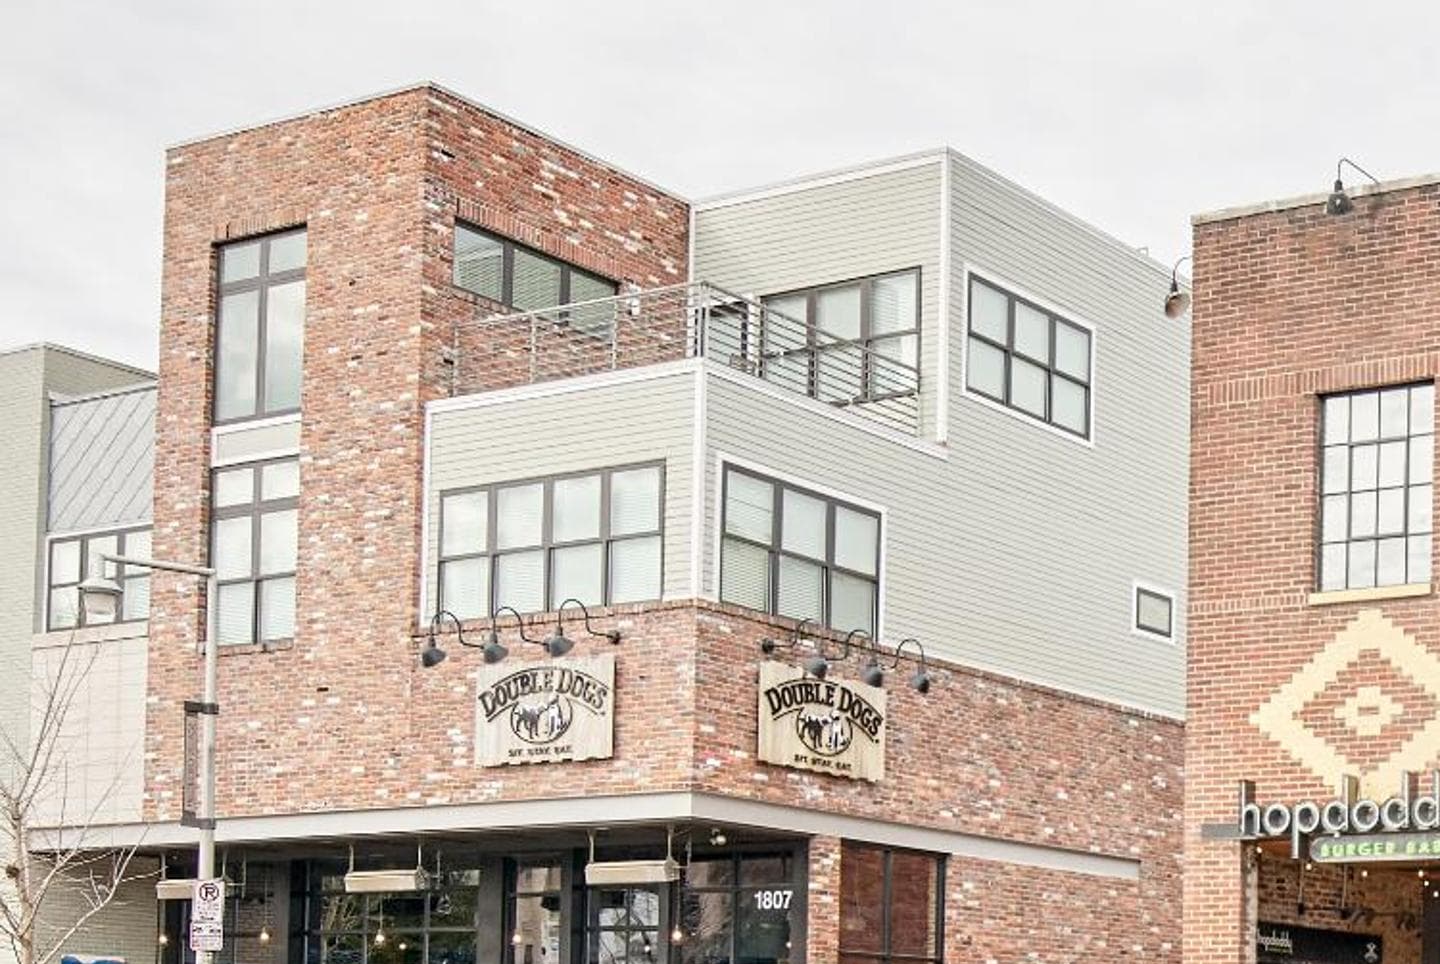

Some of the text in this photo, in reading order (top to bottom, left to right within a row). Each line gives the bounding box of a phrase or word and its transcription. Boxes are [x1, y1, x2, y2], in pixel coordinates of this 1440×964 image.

[478, 668, 608, 718] DOUBLE DOGS
[764, 683, 882, 736] DOUBLE DOGS
[1320, 842, 1397, 858] BURGER
[753, 890, 793, 910] 1807
